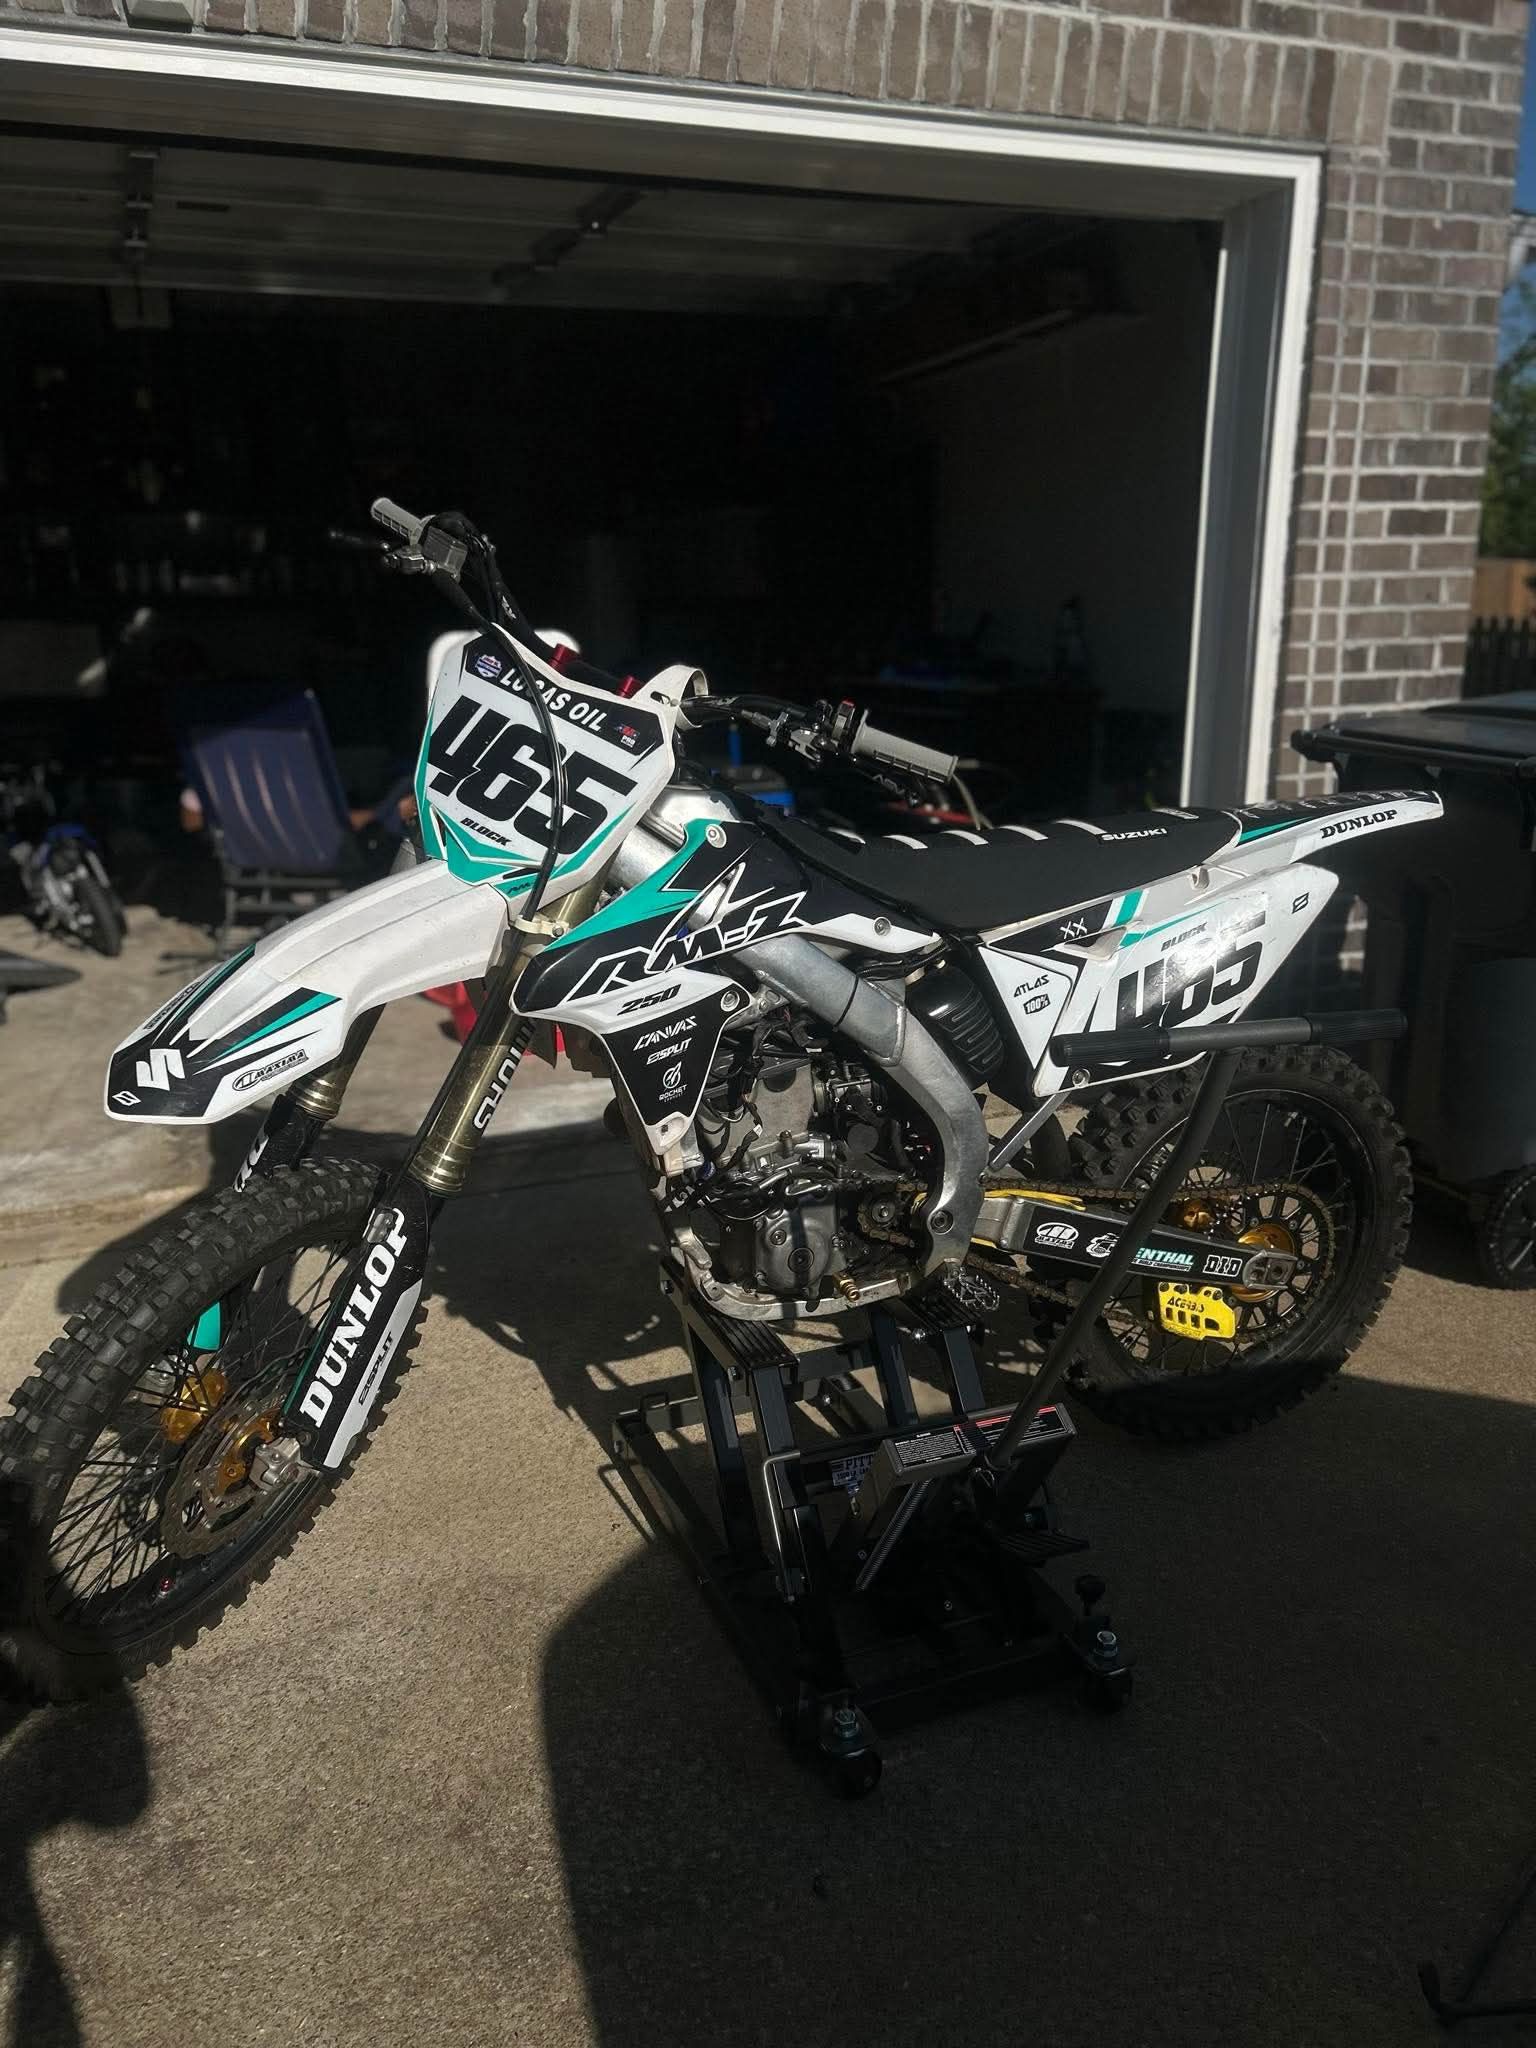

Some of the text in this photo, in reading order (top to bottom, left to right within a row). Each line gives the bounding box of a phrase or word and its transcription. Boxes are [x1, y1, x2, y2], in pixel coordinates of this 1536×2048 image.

[568, 702, 608, 732] OIL
[427, 695, 638, 855] 465
[460, 817, 512, 846] BLOCK
[1101, 827, 1168, 842] SUZUKI
[1320, 809, 1398, 839] DUNLOP
[1161, 921, 1208, 952] BLOCK
[617, 984, 682, 1016] 250
[1013, 974, 1051, 998] ATLAS
[1025, 994, 1051, 1014] 100%
[633, 1016, 698, 1051] CANVAS
[254, 1050, 306, 1081] MAXIMA
[1136, 1248, 1194, 1266] ENTHAL
[300, 1207, 407, 1428] DUNLOP
